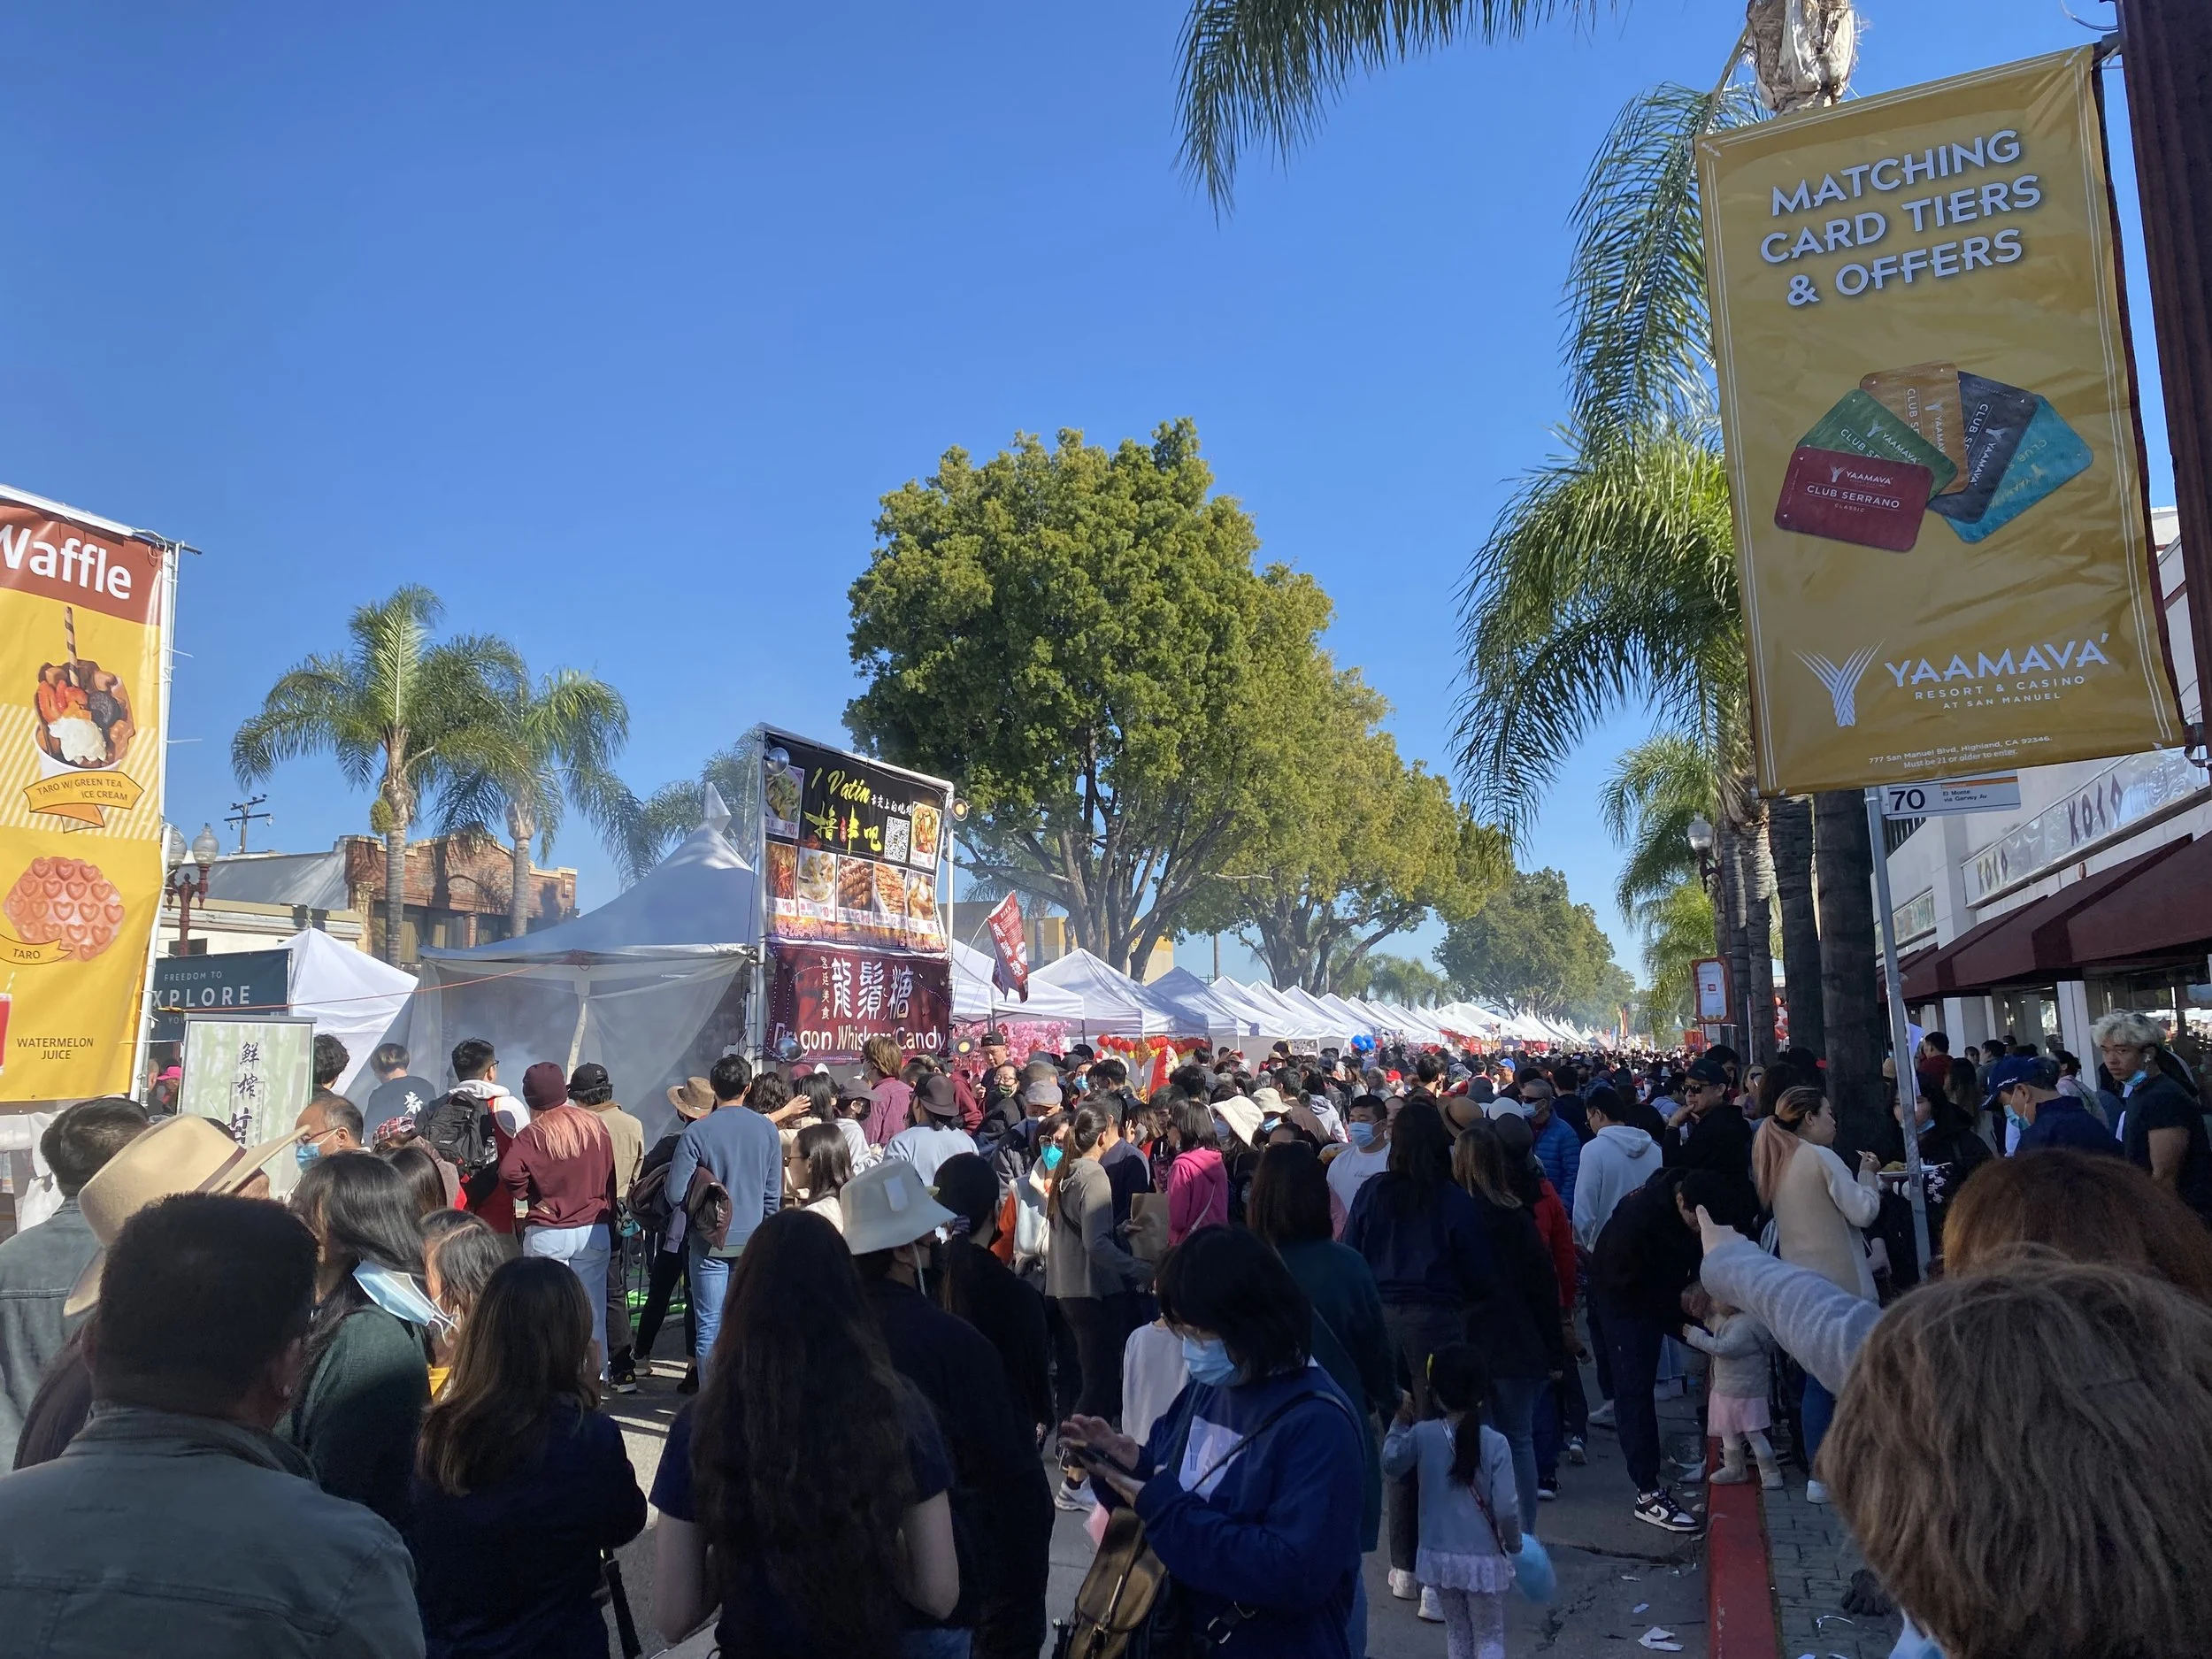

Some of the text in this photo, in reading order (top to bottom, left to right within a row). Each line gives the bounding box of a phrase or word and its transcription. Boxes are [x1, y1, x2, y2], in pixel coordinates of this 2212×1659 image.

[1771, 129, 2022, 217] MATCHING
[1761, 174, 2041, 264] CARD TIERS
[1786, 228, 2023, 306] & OFFERS
[1907, 388, 1917, 418] CLUB
[1969, 403, 1989, 434] CLUB
[1840, 428, 1867, 451] CLUB
[2017, 439, 2047, 462] CLUB
[1807, 485, 1900, 508] CLUB SERRANO
[1834, 503, 1865, 513] CLASSIC
[1915, 675, 2085, 701] RESORT & CASINO
[1943, 692, 2062, 710] AT SAN MANUEL
[1868, 756, 1884, 764] 777
[1903, 749, 1935, 759] Manuel
[1904, 759, 1924, 769] Must
[1959, 752, 1981, 762] older
[36, 778, 123, 795] TARO W/ GREEN TEA
[81, 790, 128, 801] ICE CREAM
[1889, 788, 1925, 811] 70
[12, 949, 41, 959] TARO
[164, 972, 206, 981] FREEDOM
[153, 985, 250, 1008] XPLORE
[17, 1037, 94, 1048] WATERMELON
[895, 1025, 946, 1055] Candy
[41, 1049, 72, 1060] JUICE
